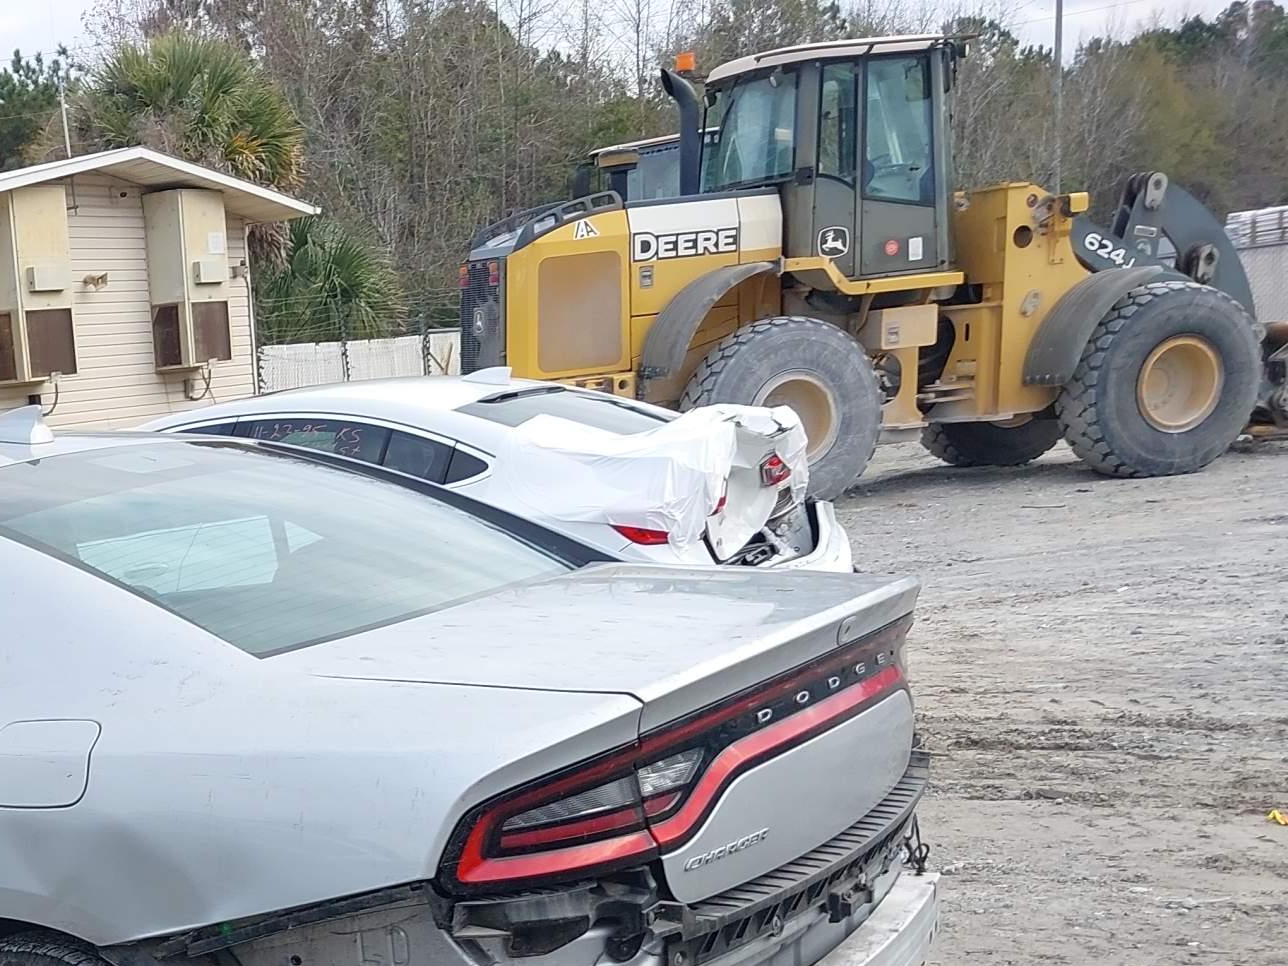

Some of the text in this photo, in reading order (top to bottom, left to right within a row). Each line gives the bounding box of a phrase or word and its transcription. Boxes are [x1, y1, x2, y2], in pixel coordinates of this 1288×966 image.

[634, 227, 739, 262] DEERE
[757, 652, 887, 724] DODGE
[684, 827, 770, 872] CHARGER
